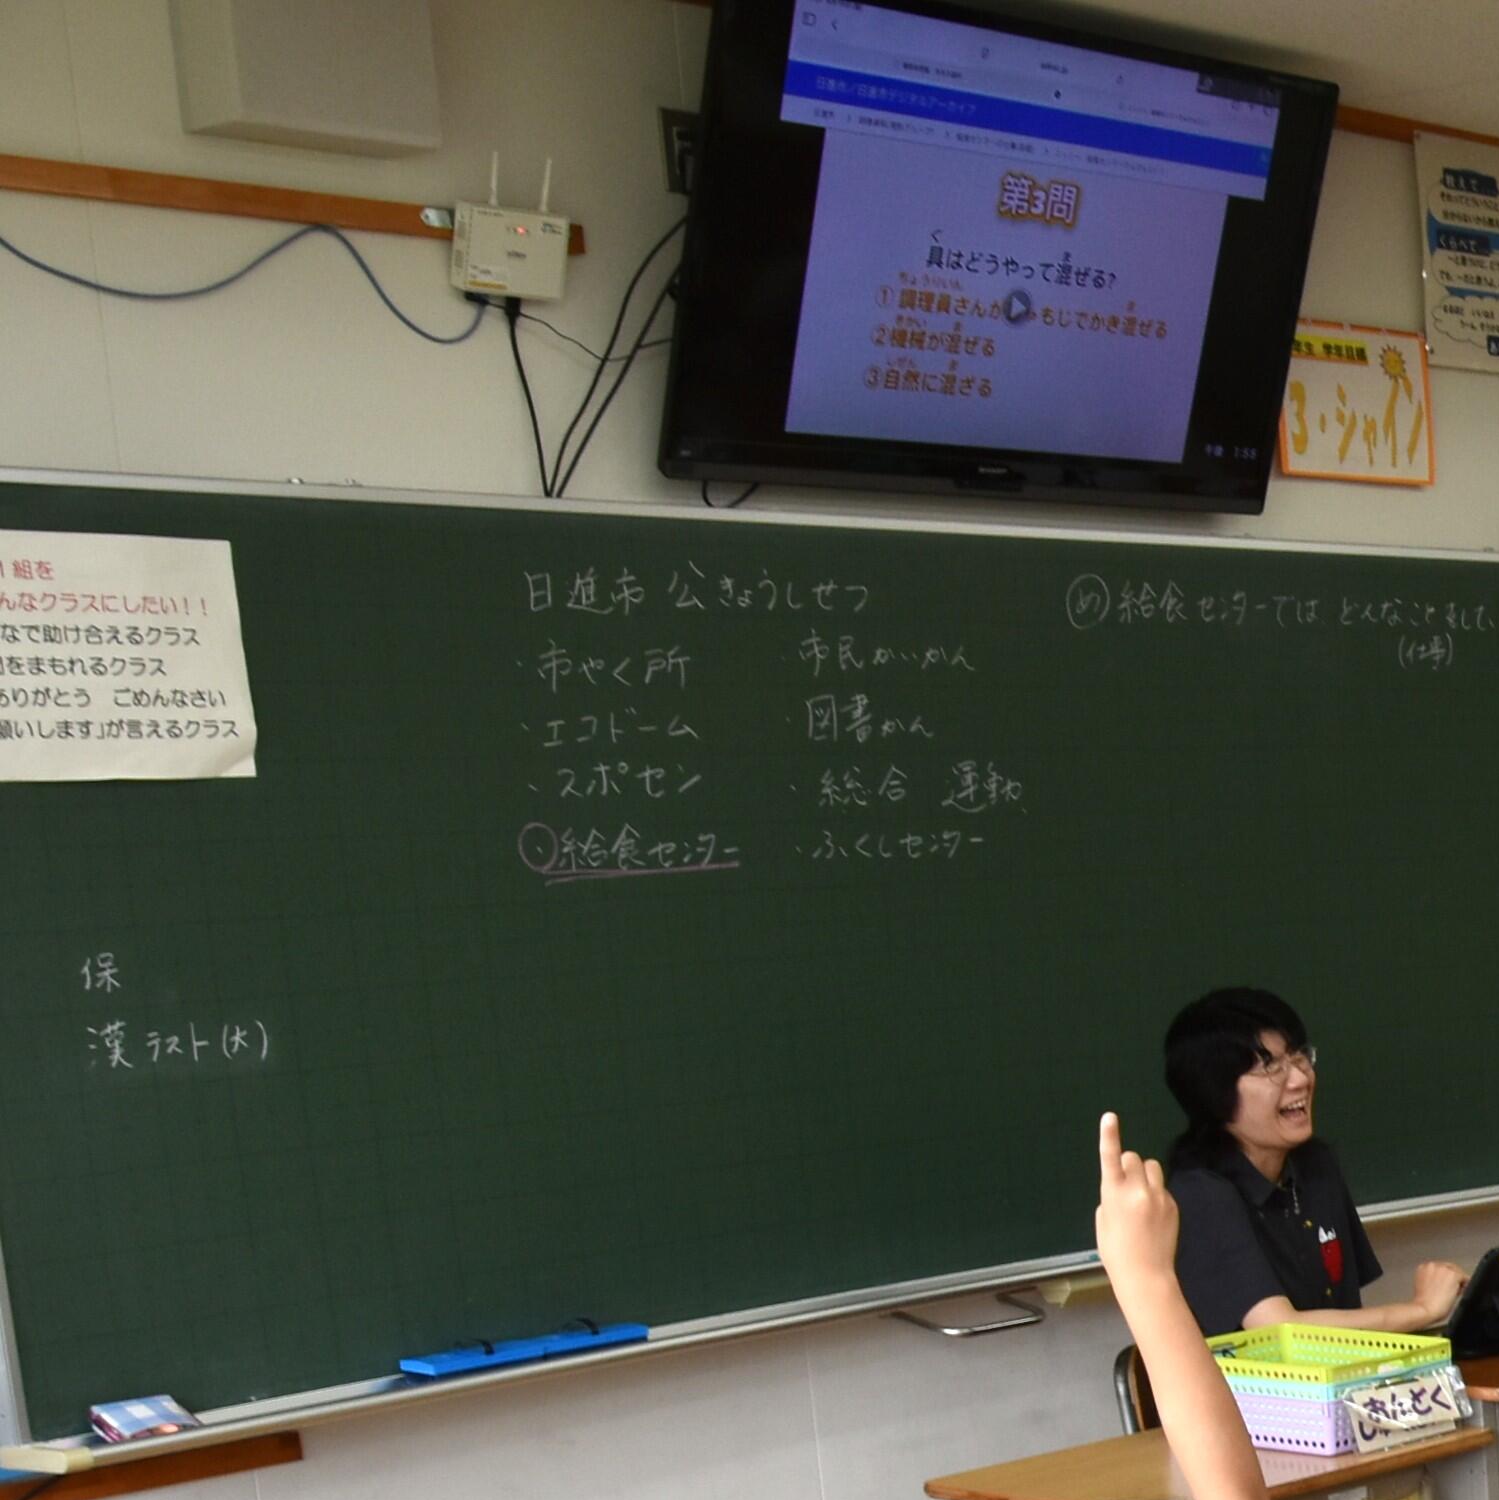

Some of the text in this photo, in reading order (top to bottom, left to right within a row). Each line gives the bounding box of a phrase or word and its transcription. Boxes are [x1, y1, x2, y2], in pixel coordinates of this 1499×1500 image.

[999, 173, 1080, 226] 第3問
[0, 656, 168, 677] をまもれるクラス
[536, 639, 692, 694] 市やく所
[113, 688, 227, 709] ごめんなさい
[806, 693, 936, 743] 図書かん
[542, 706, 701, 748] エコドーム
[556, 759, 702, 798] スポセン
[557, 822, 741, 871] 給食センター
[81, 951, 122, 994] 保
